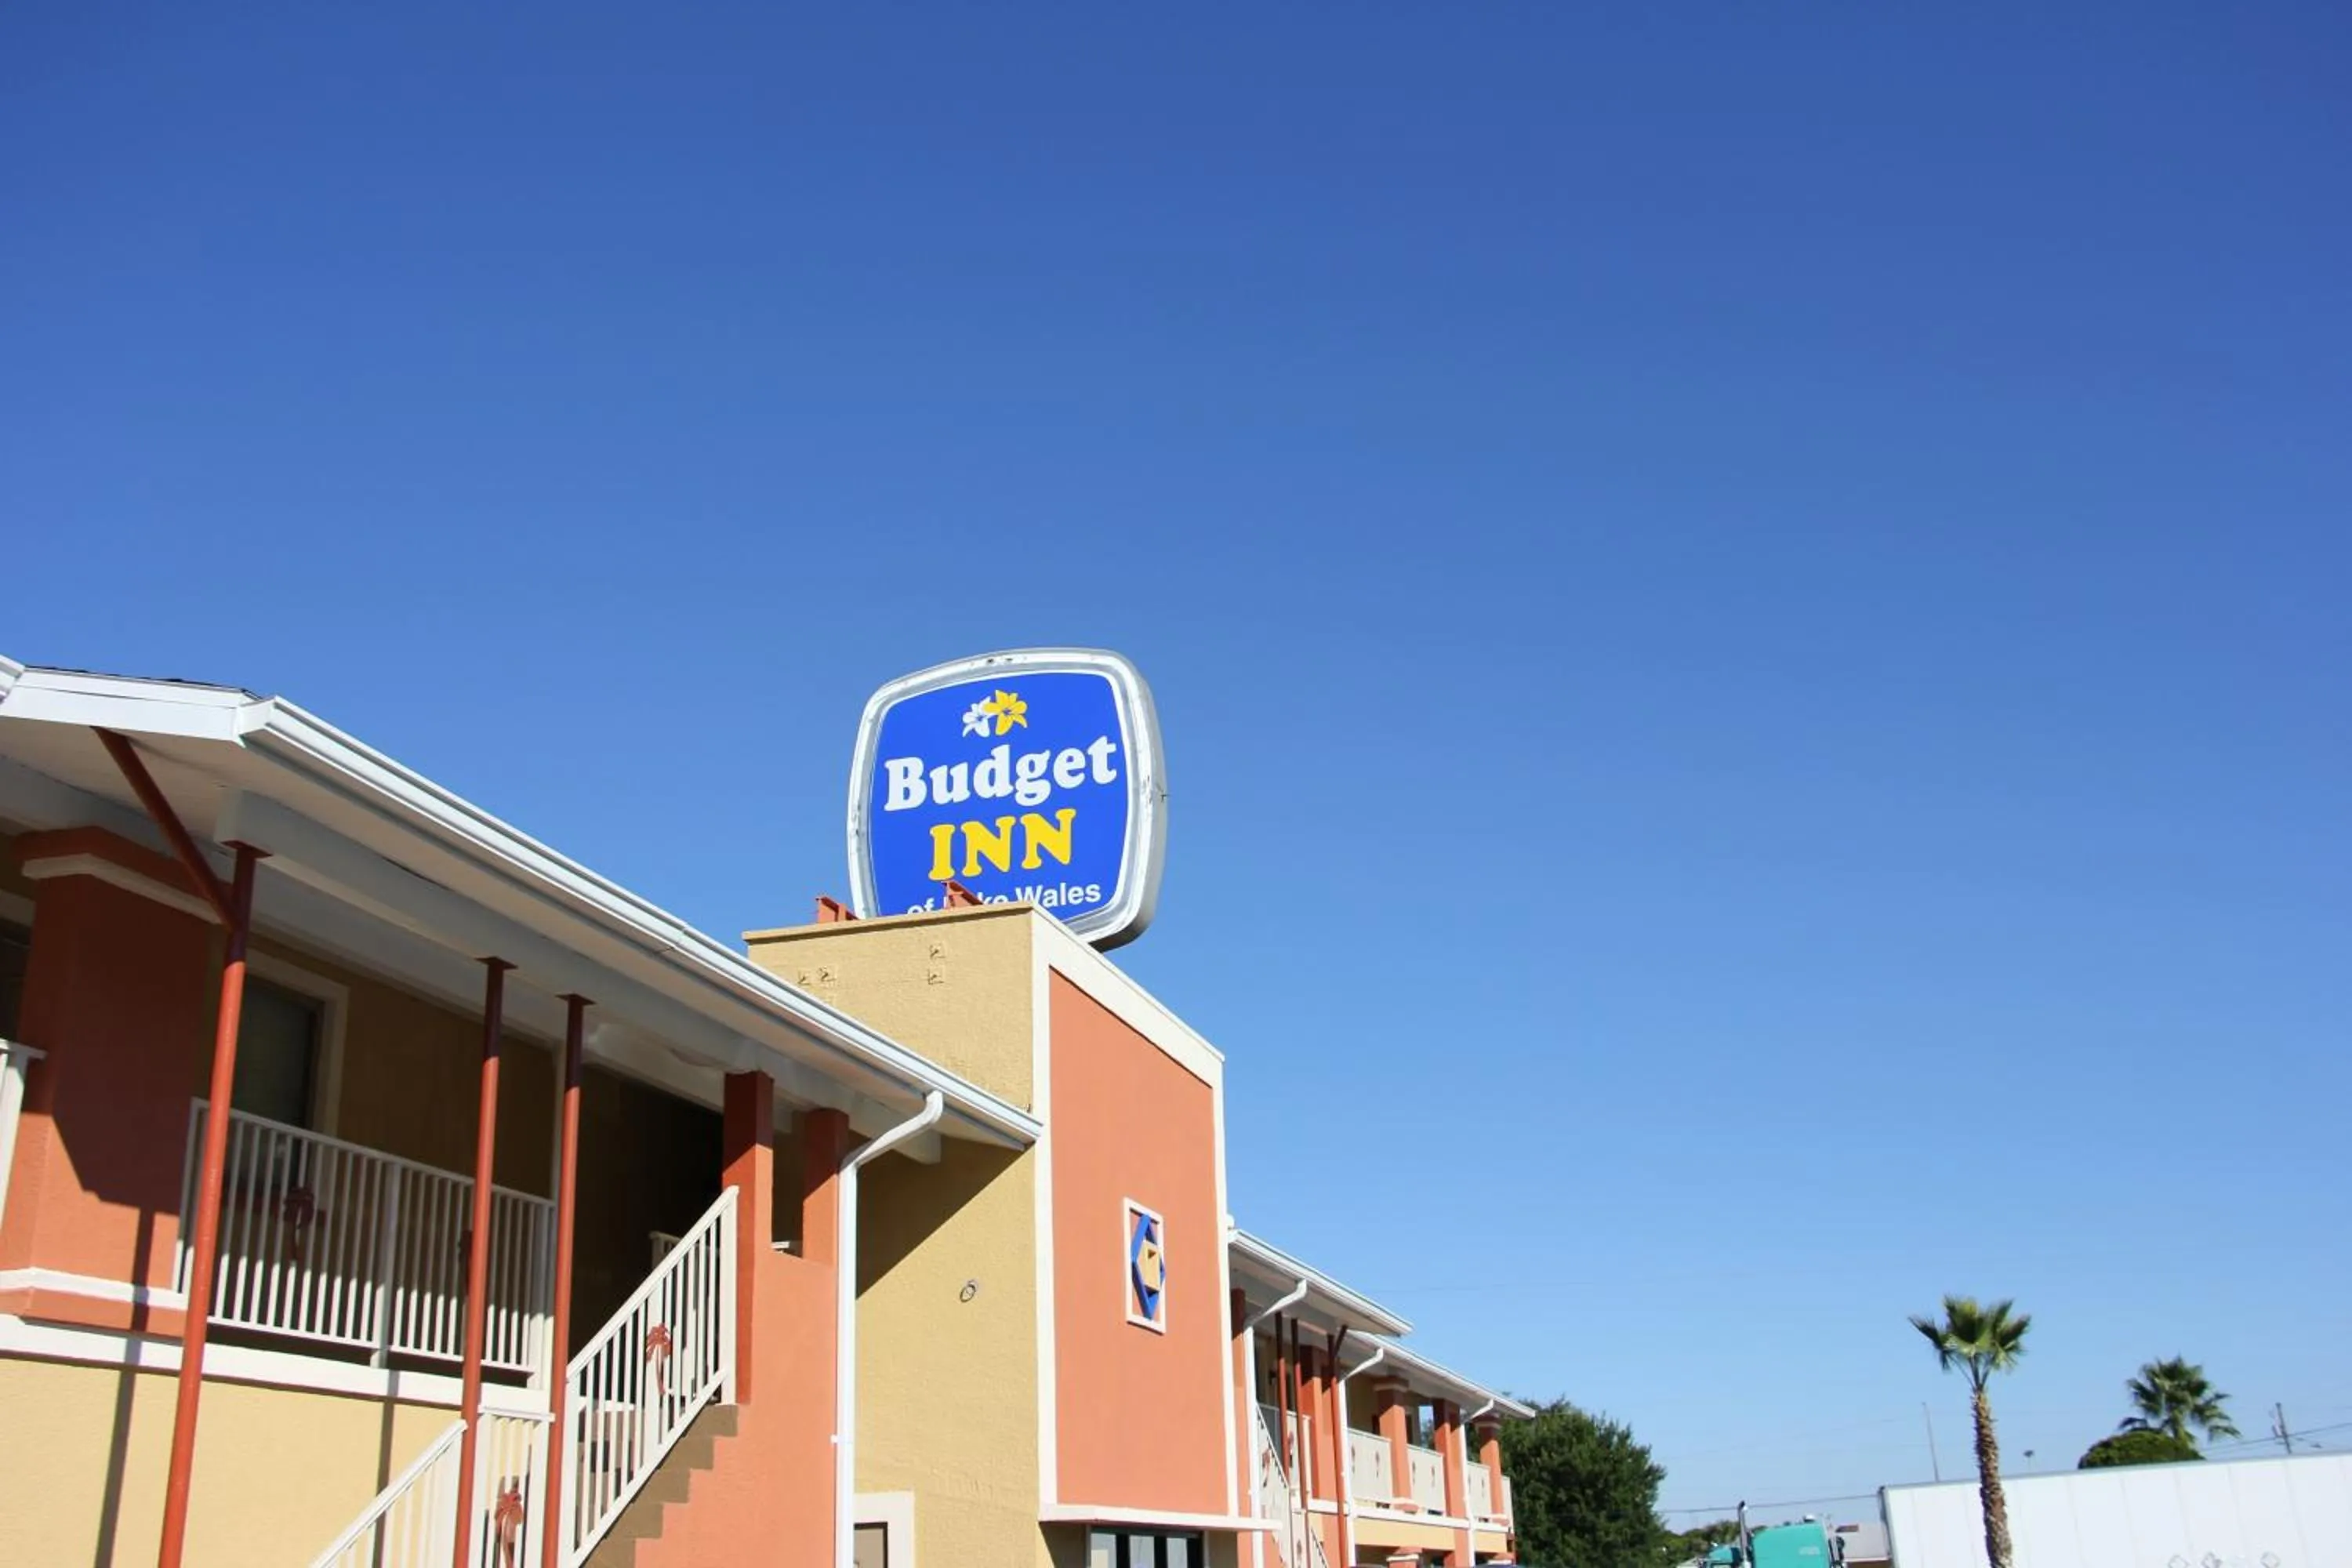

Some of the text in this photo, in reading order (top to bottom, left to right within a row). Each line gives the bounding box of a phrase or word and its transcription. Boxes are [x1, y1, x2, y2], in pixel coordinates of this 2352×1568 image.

[884, 735, 1117, 811] Budget
[928, 808, 1076, 881] INN
[1014, 883, 1102, 909] Wales
